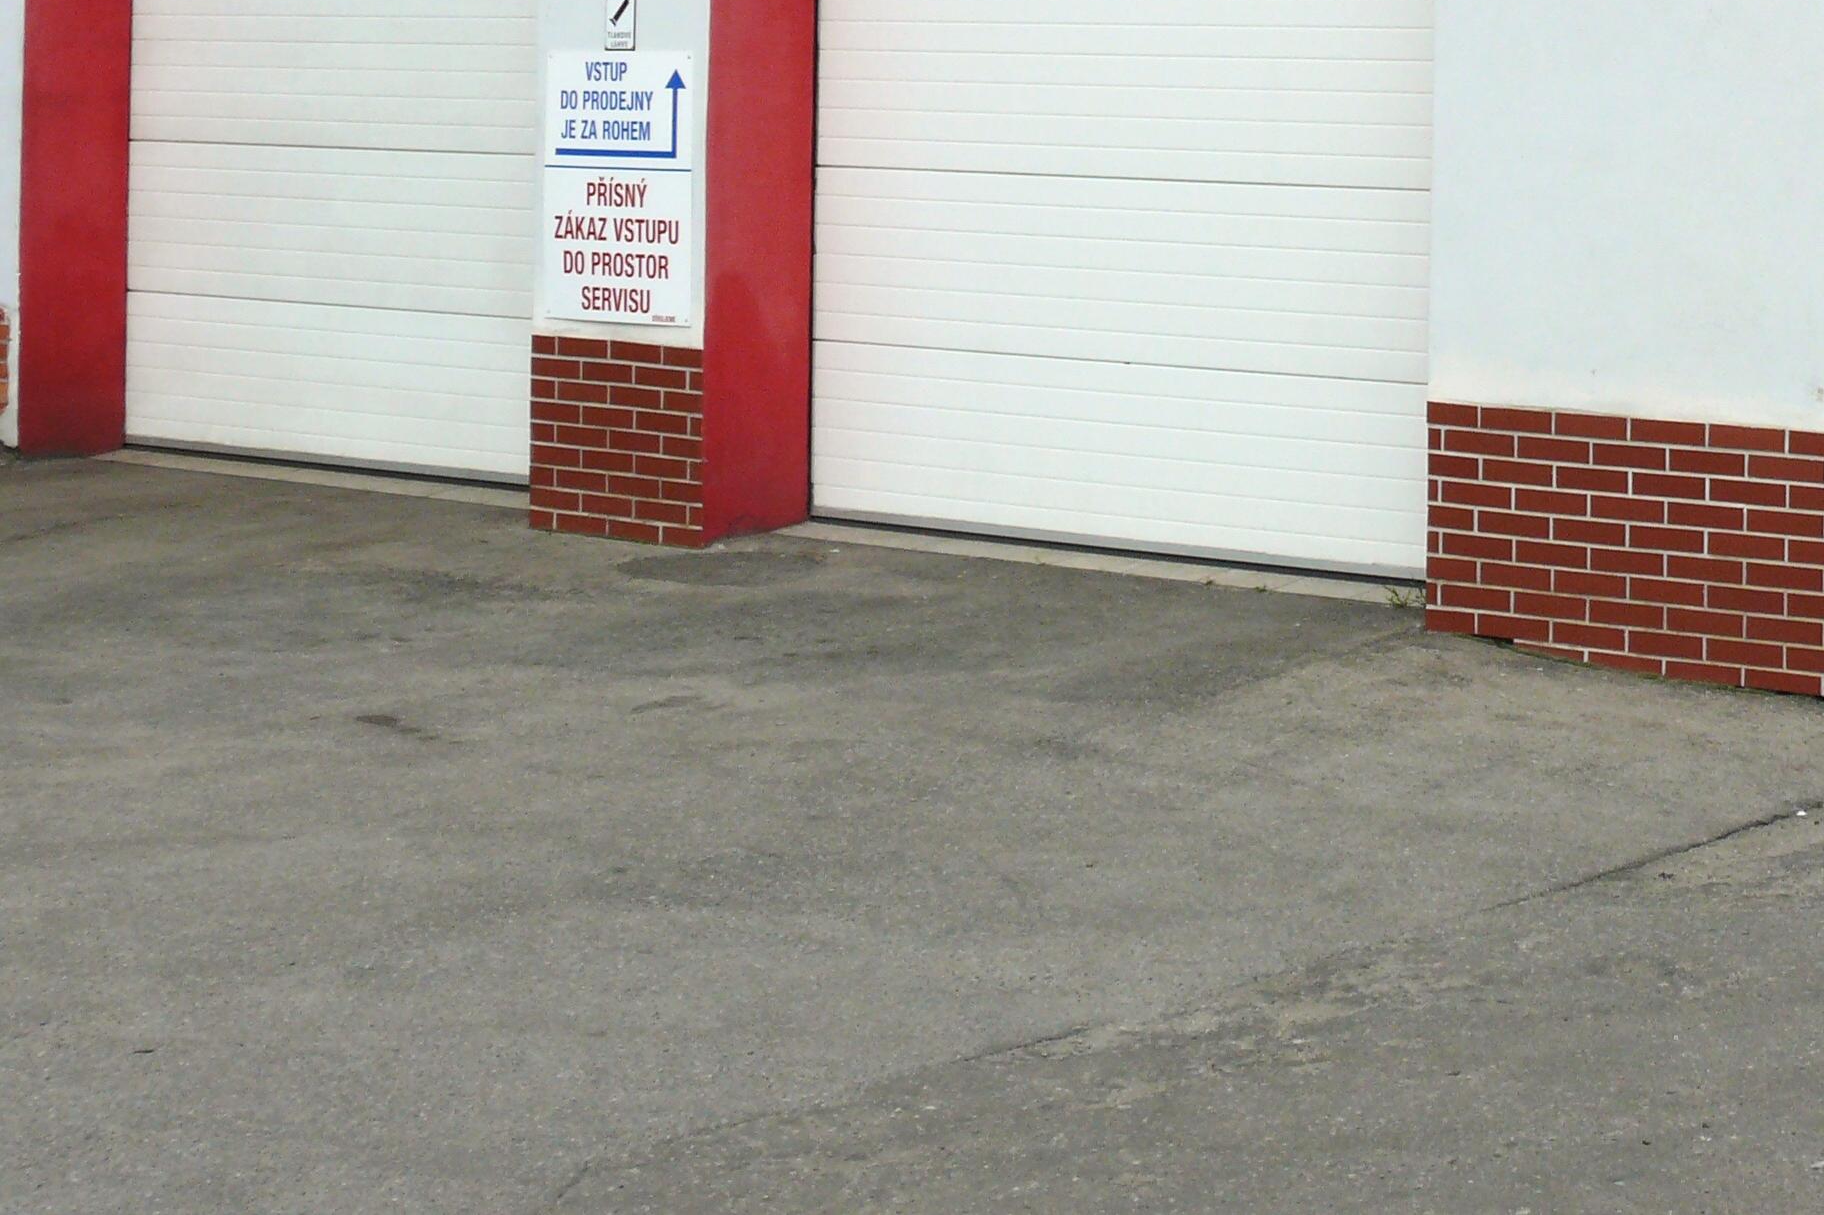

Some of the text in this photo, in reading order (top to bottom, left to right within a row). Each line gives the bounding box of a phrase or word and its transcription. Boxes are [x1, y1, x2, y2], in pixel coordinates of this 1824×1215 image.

[585, 61, 628, 82] VSTUP
[560, 90, 654, 111] DO PRODEJNY
[560, 119, 651, 142] JE ZA ROHEM
[586, 176, 647, 209] PŘÍSNÝ
[554, 210, 679, 245] ZÁKAZ VSTUPU
[563, 250, 669, 280] DO PROSTOR
[581, 286, 651, 314] SERVISU
